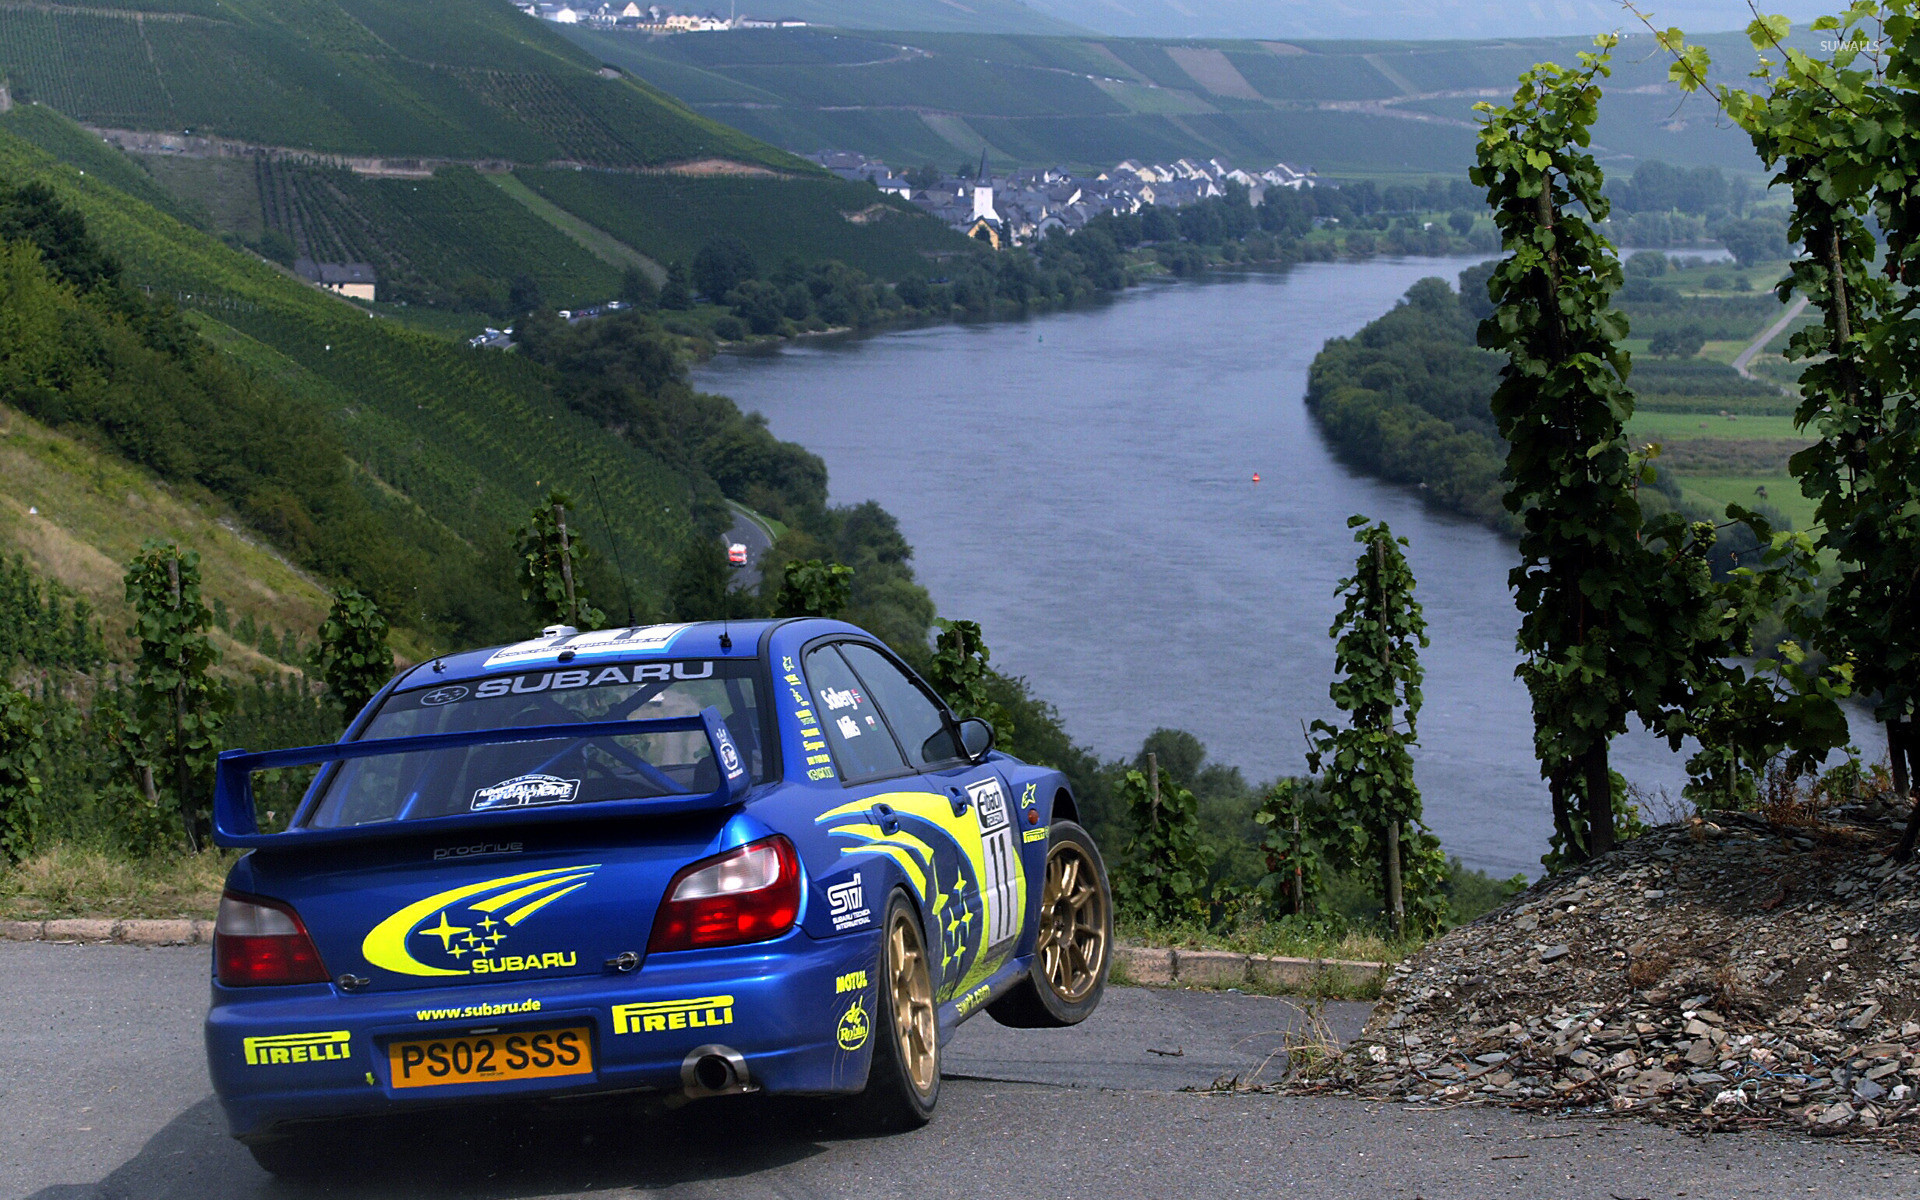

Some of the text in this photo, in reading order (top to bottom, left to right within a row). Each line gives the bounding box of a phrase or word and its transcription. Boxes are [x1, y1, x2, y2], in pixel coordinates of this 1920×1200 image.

[474, 661, 714, 698] SUBARU
[433, 841, 524, 860] prodrive
[989, 833, 1011, 940] 11
[471, 951, 577, 974] SUBARU
[835, 970, 868, 995] MOTUL
[416, 998, 542, 1021] www.subaru.de
[611, 995, 734, 1035] PIRELLI
[243, 1030, 351, 1066] PIRELLI
[401, 1031, 581, 1079] PS02 SSS
